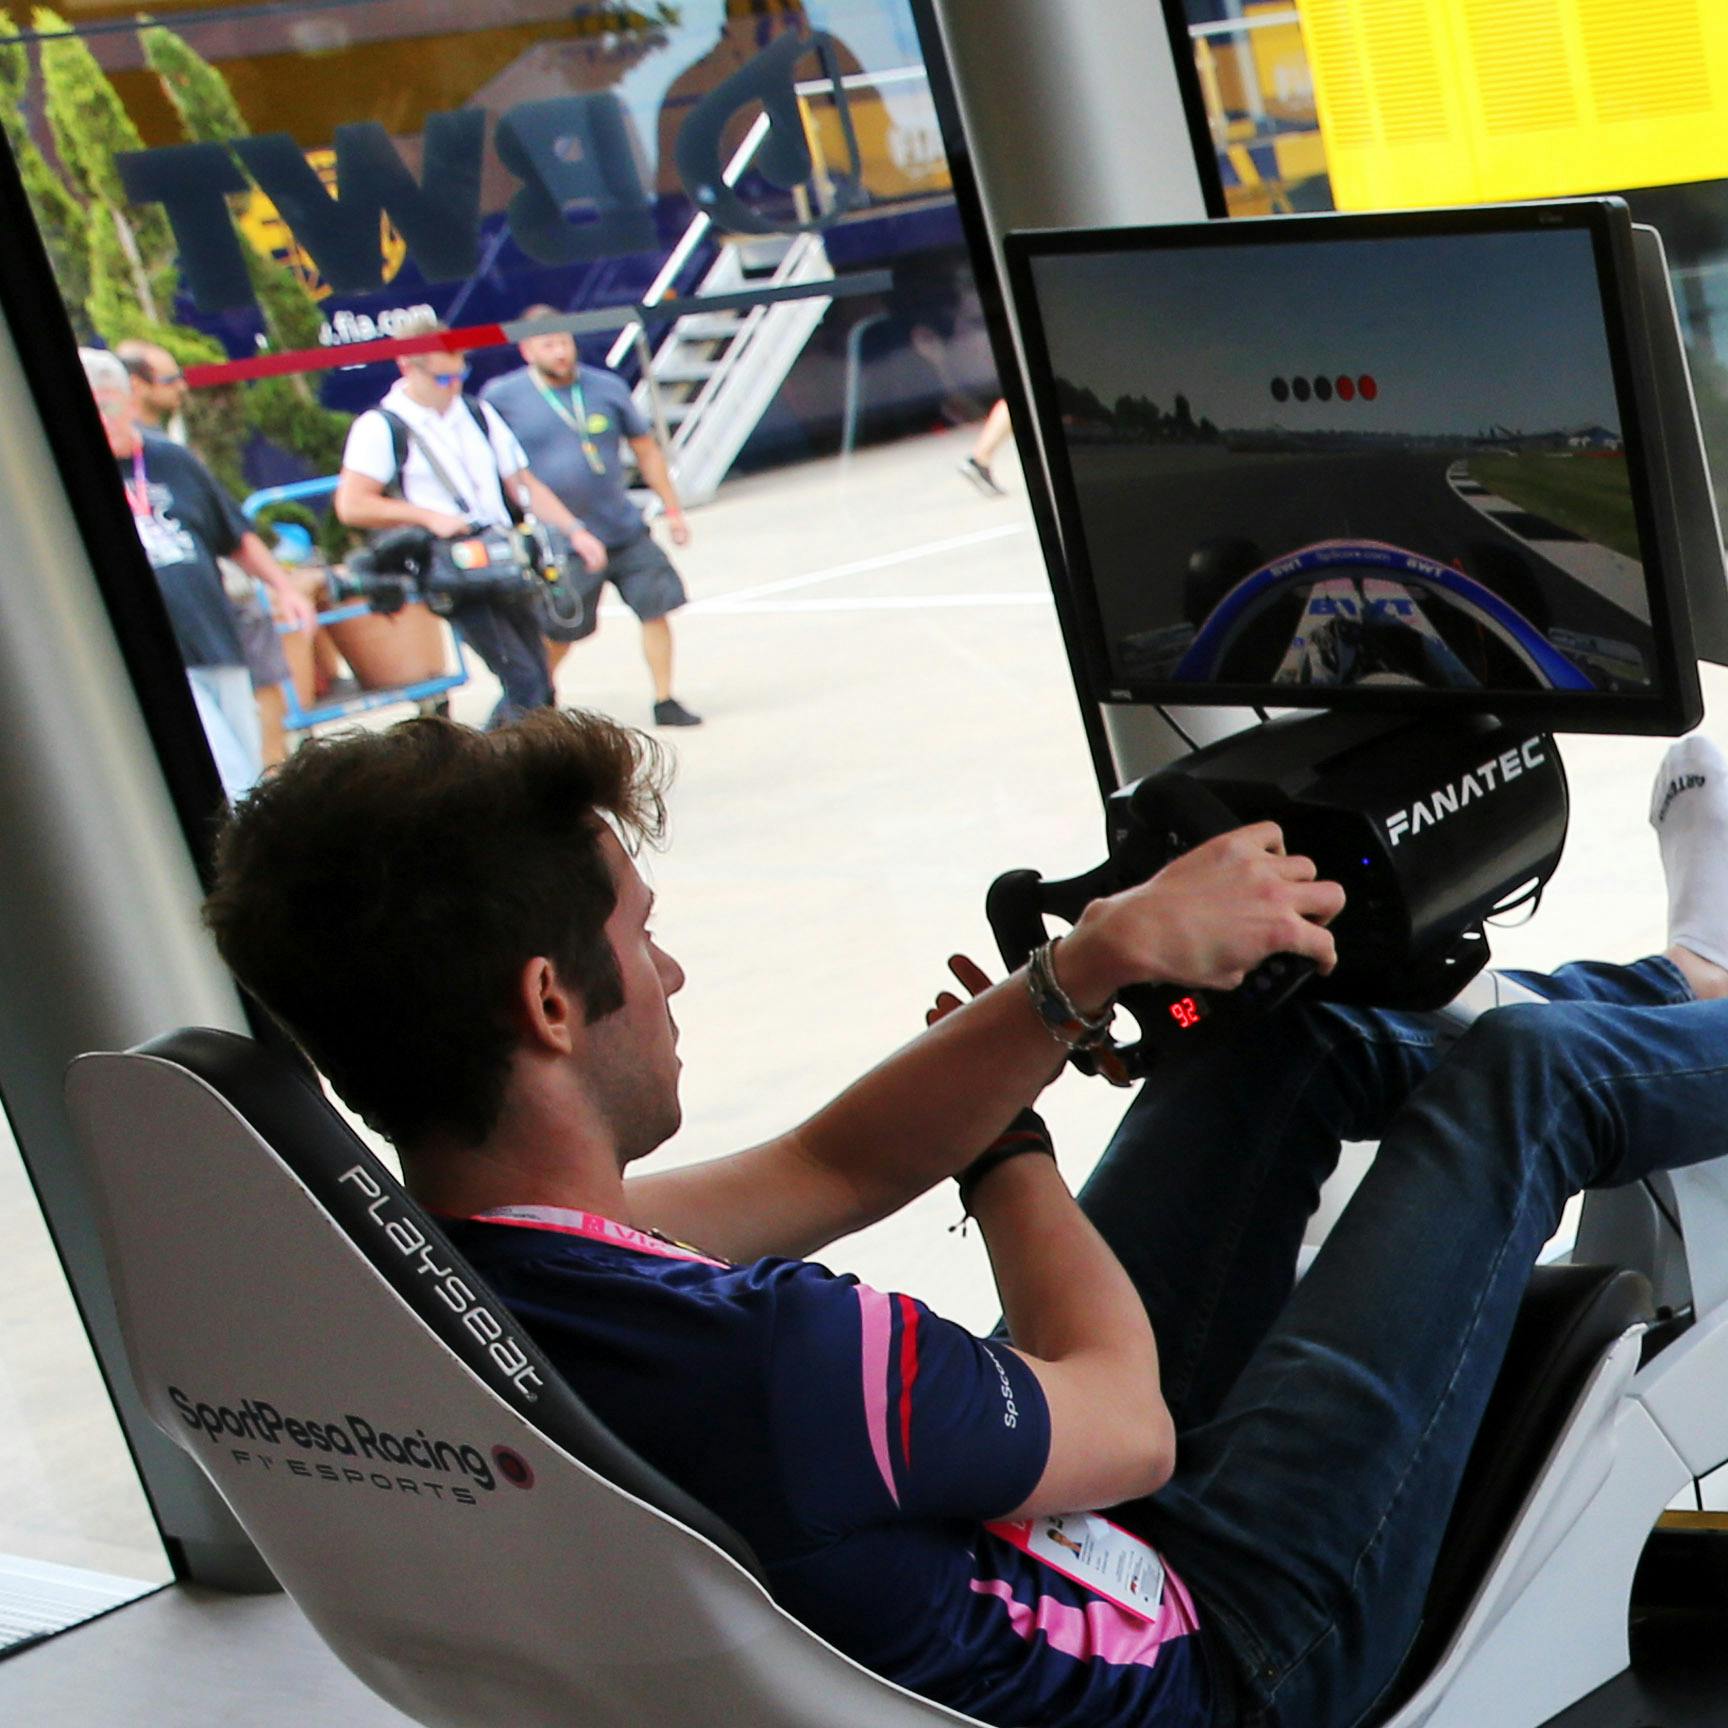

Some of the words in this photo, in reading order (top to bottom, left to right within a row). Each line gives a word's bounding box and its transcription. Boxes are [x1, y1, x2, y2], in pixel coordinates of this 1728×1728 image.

[1386, 736, 1546, 847] FANATEC
[168, 1385, 358, 1457] SportPesa
[345, 1414, 496, 1491] Racing
[286, 1459, 477, 1506] ESPORTS
